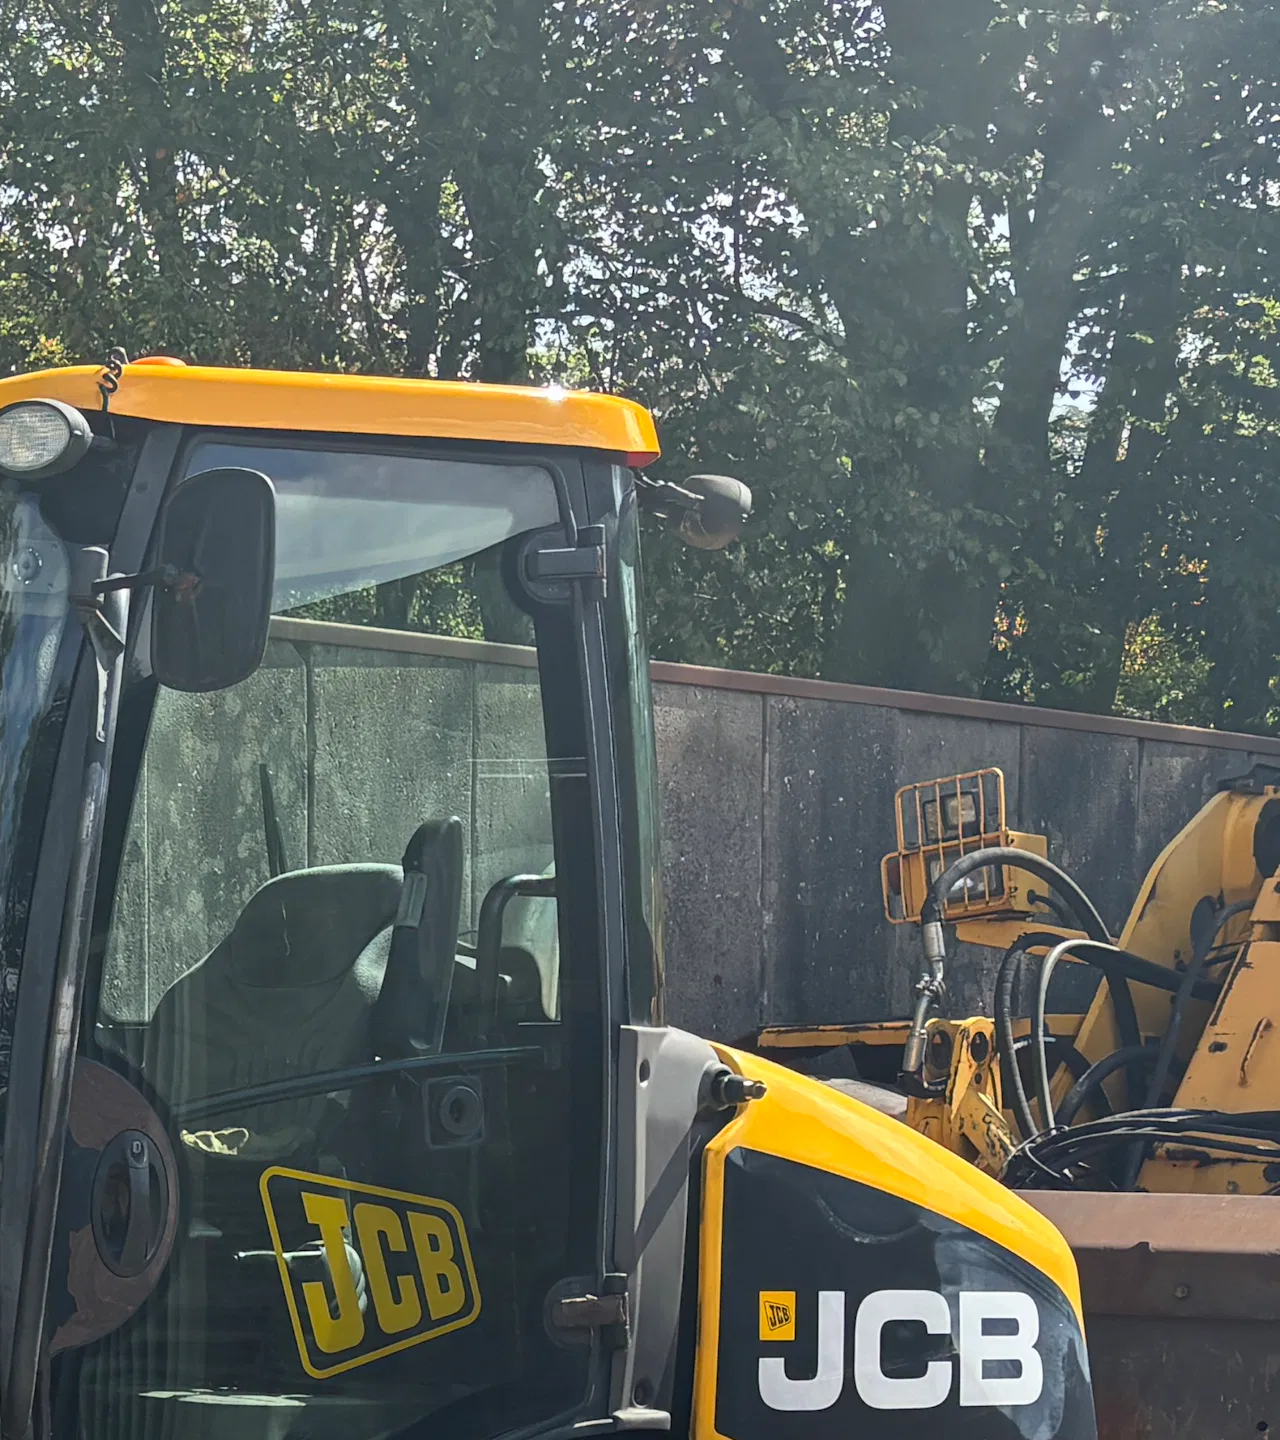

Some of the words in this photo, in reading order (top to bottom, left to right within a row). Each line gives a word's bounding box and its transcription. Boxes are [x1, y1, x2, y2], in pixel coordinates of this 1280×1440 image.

[300, 1191, 466, 1354] JCB
[768, 1304, 791, 1328] JCB
[758, 1289, 1044, 1412] JCB
